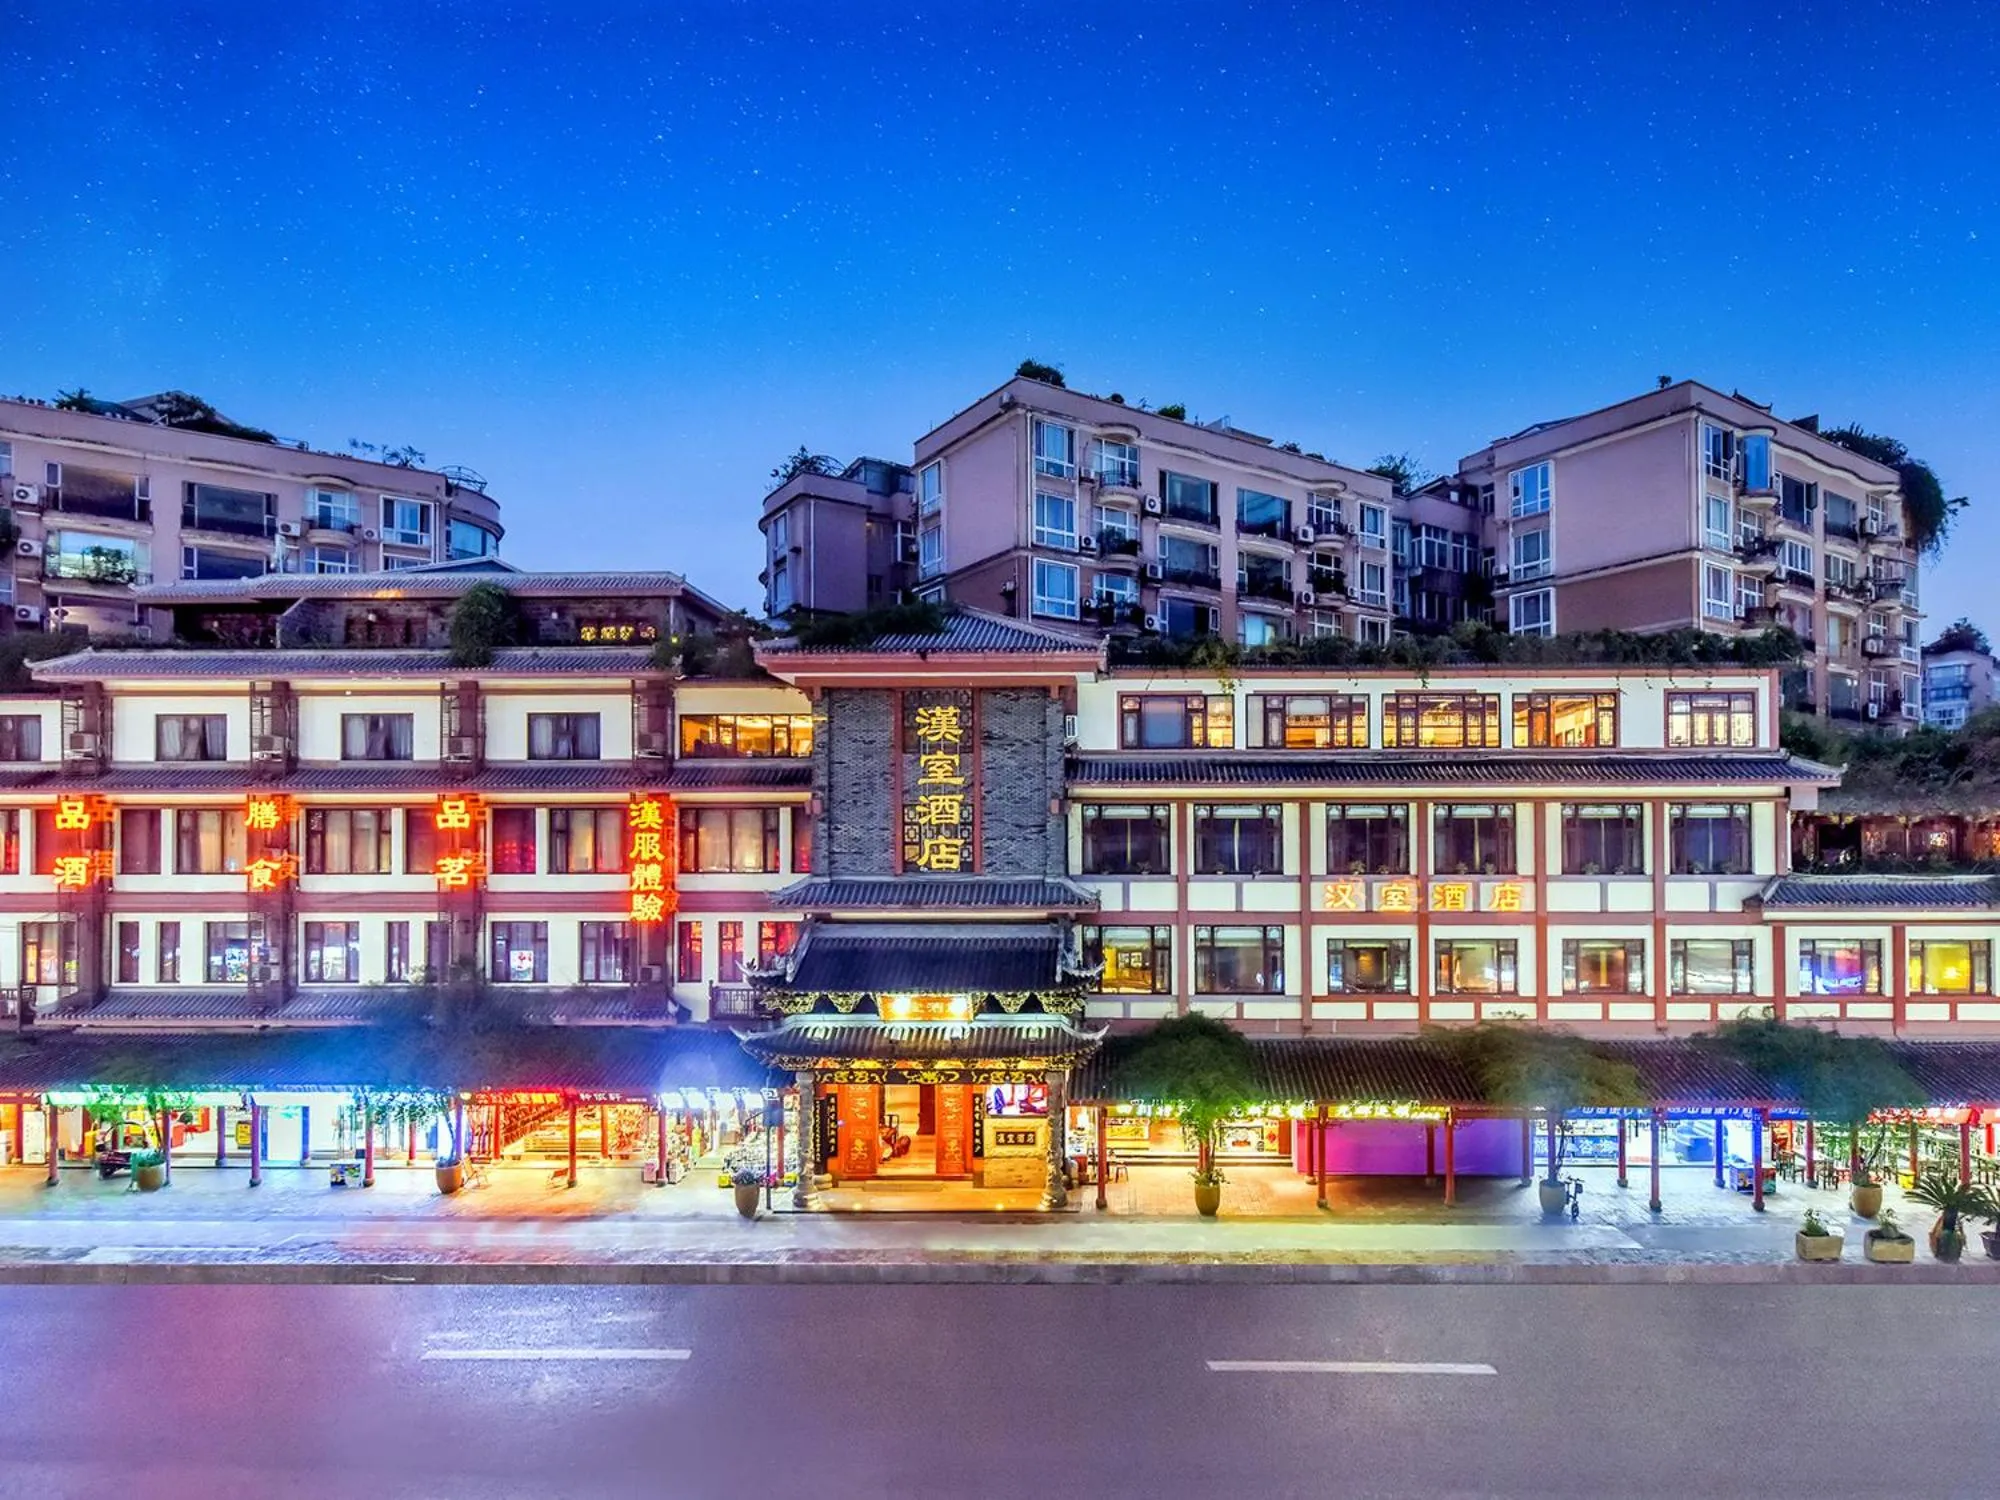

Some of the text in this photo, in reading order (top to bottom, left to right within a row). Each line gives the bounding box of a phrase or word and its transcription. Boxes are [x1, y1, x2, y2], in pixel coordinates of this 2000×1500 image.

[915, 706, 964, 871] 漢室酒店
[53, 800, 91, 885] 品酒
[244, 800, 281, 888] 膳食
[436, 800, 472, 885] 品茗
[629, 801, 664, 921] 漢服體驗
[1324, 883, 1522, 911] 汉室酒店
